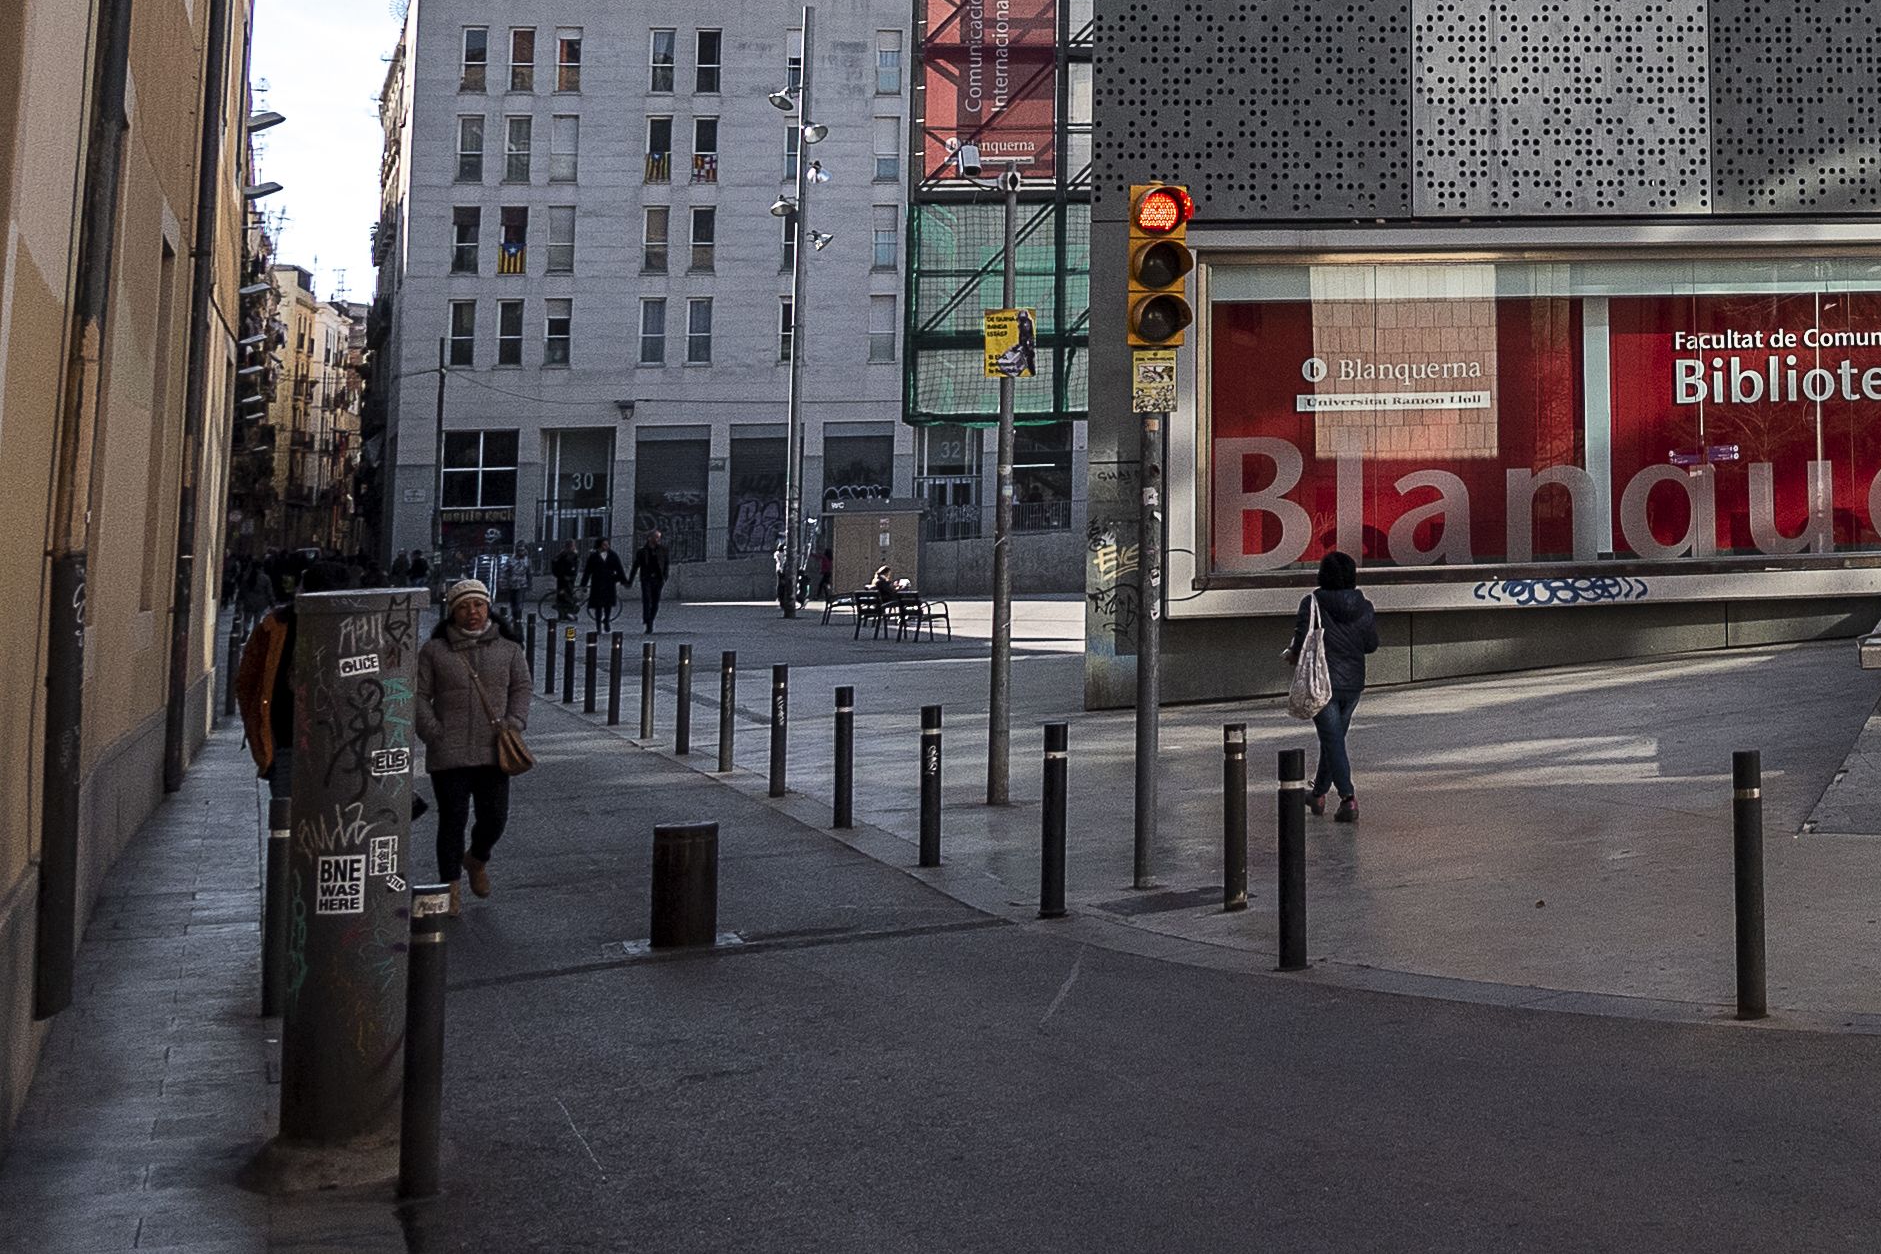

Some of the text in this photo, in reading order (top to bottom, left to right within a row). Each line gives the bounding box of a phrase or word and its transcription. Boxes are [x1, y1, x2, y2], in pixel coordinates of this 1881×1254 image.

[1674, 329, 1764, 350] Facultat
[1770, 328, 1797, 347] de
[1338, 358, 1482, 386] Blanquerna
[1306, 394, 1481, 408] Universitat Ramon Llull
[940, 441, 961, 459] 32
[571, 471, 594, 491] 30
[831, 501, 845, 509] WC
[320, 858, 362, 883] BNE
[319, 883, 361, 897] WAS
[318, 897, 361, 911] HERE
